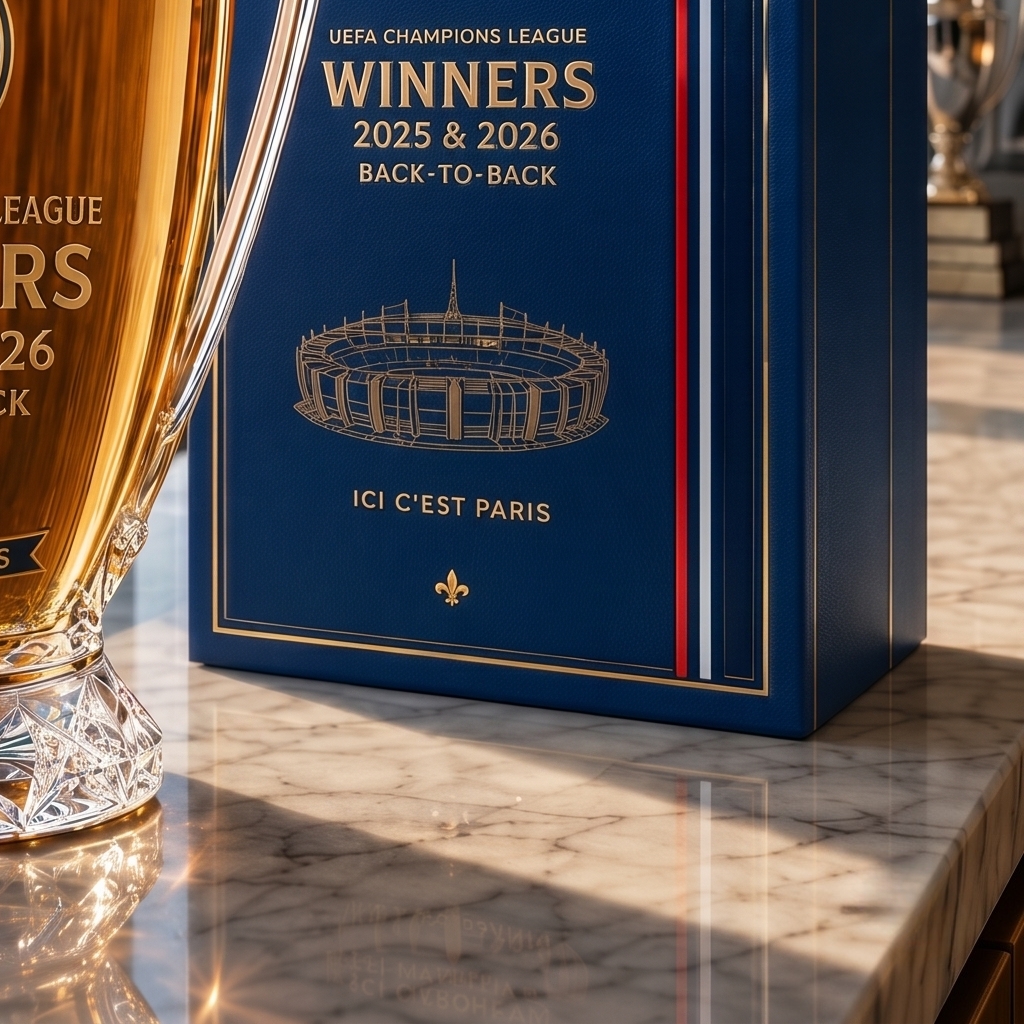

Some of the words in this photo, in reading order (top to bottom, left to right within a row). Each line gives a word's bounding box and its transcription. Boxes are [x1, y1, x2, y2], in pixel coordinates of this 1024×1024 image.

[329, 28, 377, 45] UEFA
[383, 28, 502, 45] CHAMPIONS
[508, 28, 588, 45] LEAGUE
[321, 60, 597, 110] WINNERS
[353, 120, 433, 149] 2025
[442, 121, 467, 150] &
[476, 121, 561, 151] 2026
[358, 162, 558, 187] BACK-TO-BACK
[352, 489, 385, 510] ICI
[394, 492, 467, 517] C'EST
[475, 497, 552, 524] PARIS
